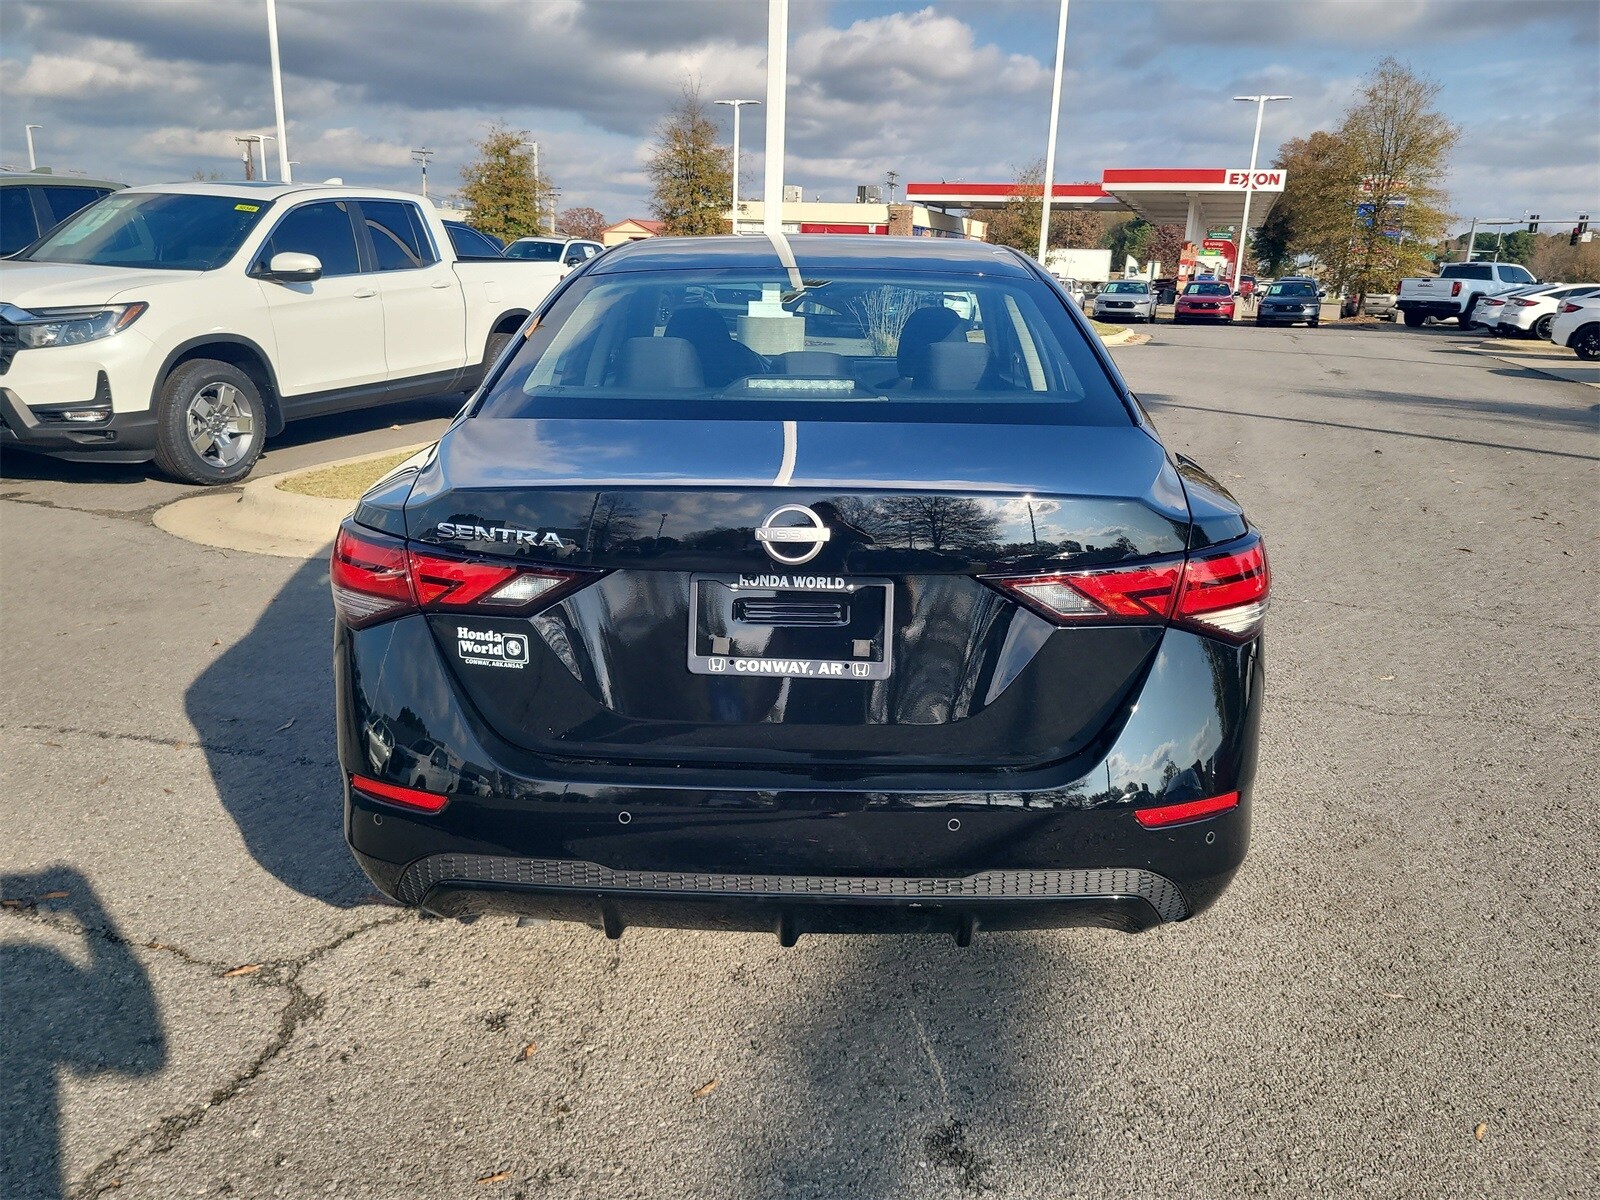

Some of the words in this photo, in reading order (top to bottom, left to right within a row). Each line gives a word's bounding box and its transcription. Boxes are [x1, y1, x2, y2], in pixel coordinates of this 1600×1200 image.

[1229, 173, 1281, 190] EXXON
[437, 522, 564, 548] SENTRA
[756, 529, 827, 541] NISSA
[739, 574, 789, 588] HONDA
[792, 576, 845, 590] WORLD
[457, 627, 502, 643] Honda
[460, 640, 503, 655] World
[465, 658, 491, 668] CONWAY,
[492, 661, 524, 669] ARKANSAS
[735, 659, 813, 675] CONWAY,
[818, 662, 843, 675] AR
